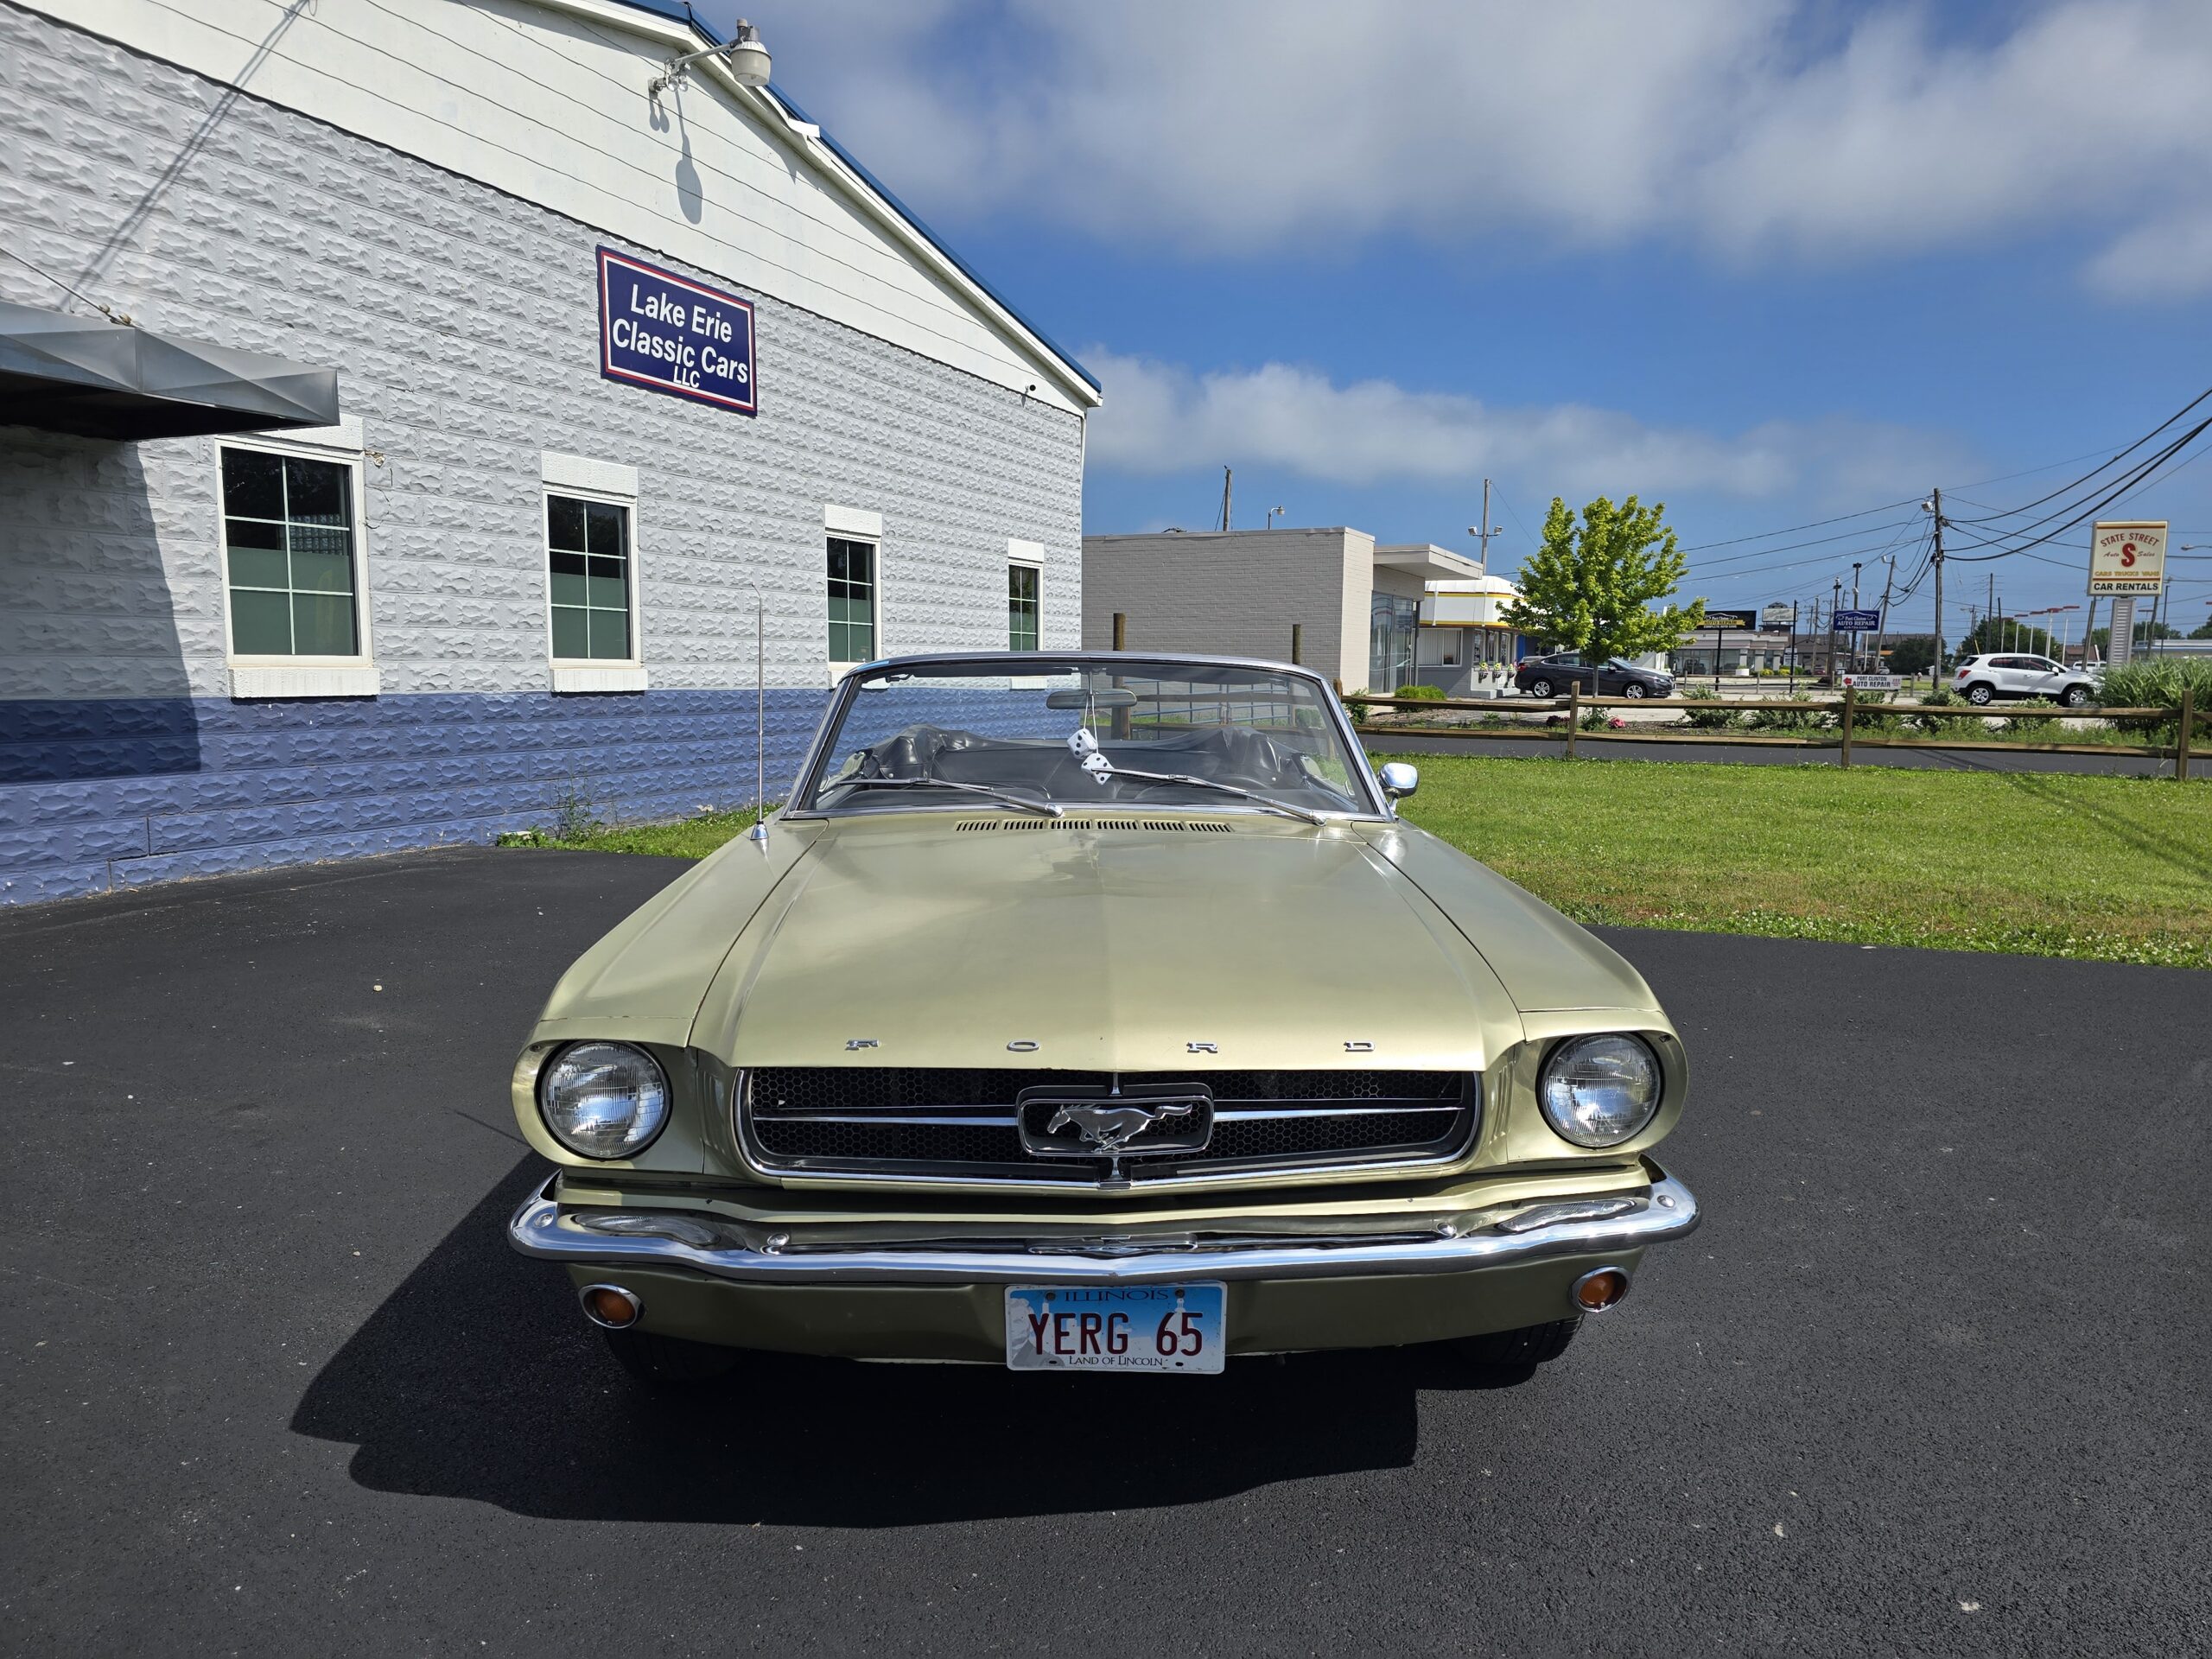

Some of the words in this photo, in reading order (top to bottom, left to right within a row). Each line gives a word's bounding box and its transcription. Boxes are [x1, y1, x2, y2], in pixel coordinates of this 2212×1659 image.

[631, 283, 685, 327] Lake
[691, 305, 733, 343] Erie
[613, 318, 695, 367] Classic
[701, 346, 748, 384] Cars
[673, 365, 701, 389] LLC
[2101, 533, 2125, 547] STATE
[2128, 532, 2159, 547] STREET
[2121, 543, 2136, 567] S
[845, 1039, 1375, 1053] FORD
[1065, 1290, 1169, 1302] ILLINOIS
[1028, 1313, 1129, 1355] YERG
[1156, 1312, 1204, 1357] 65
[1069, 1355, 1099, 1366] LAND
[1102, 1357, 1116, 1365] OF
[1118, 1354, 1163, 1367] LINCOLN
